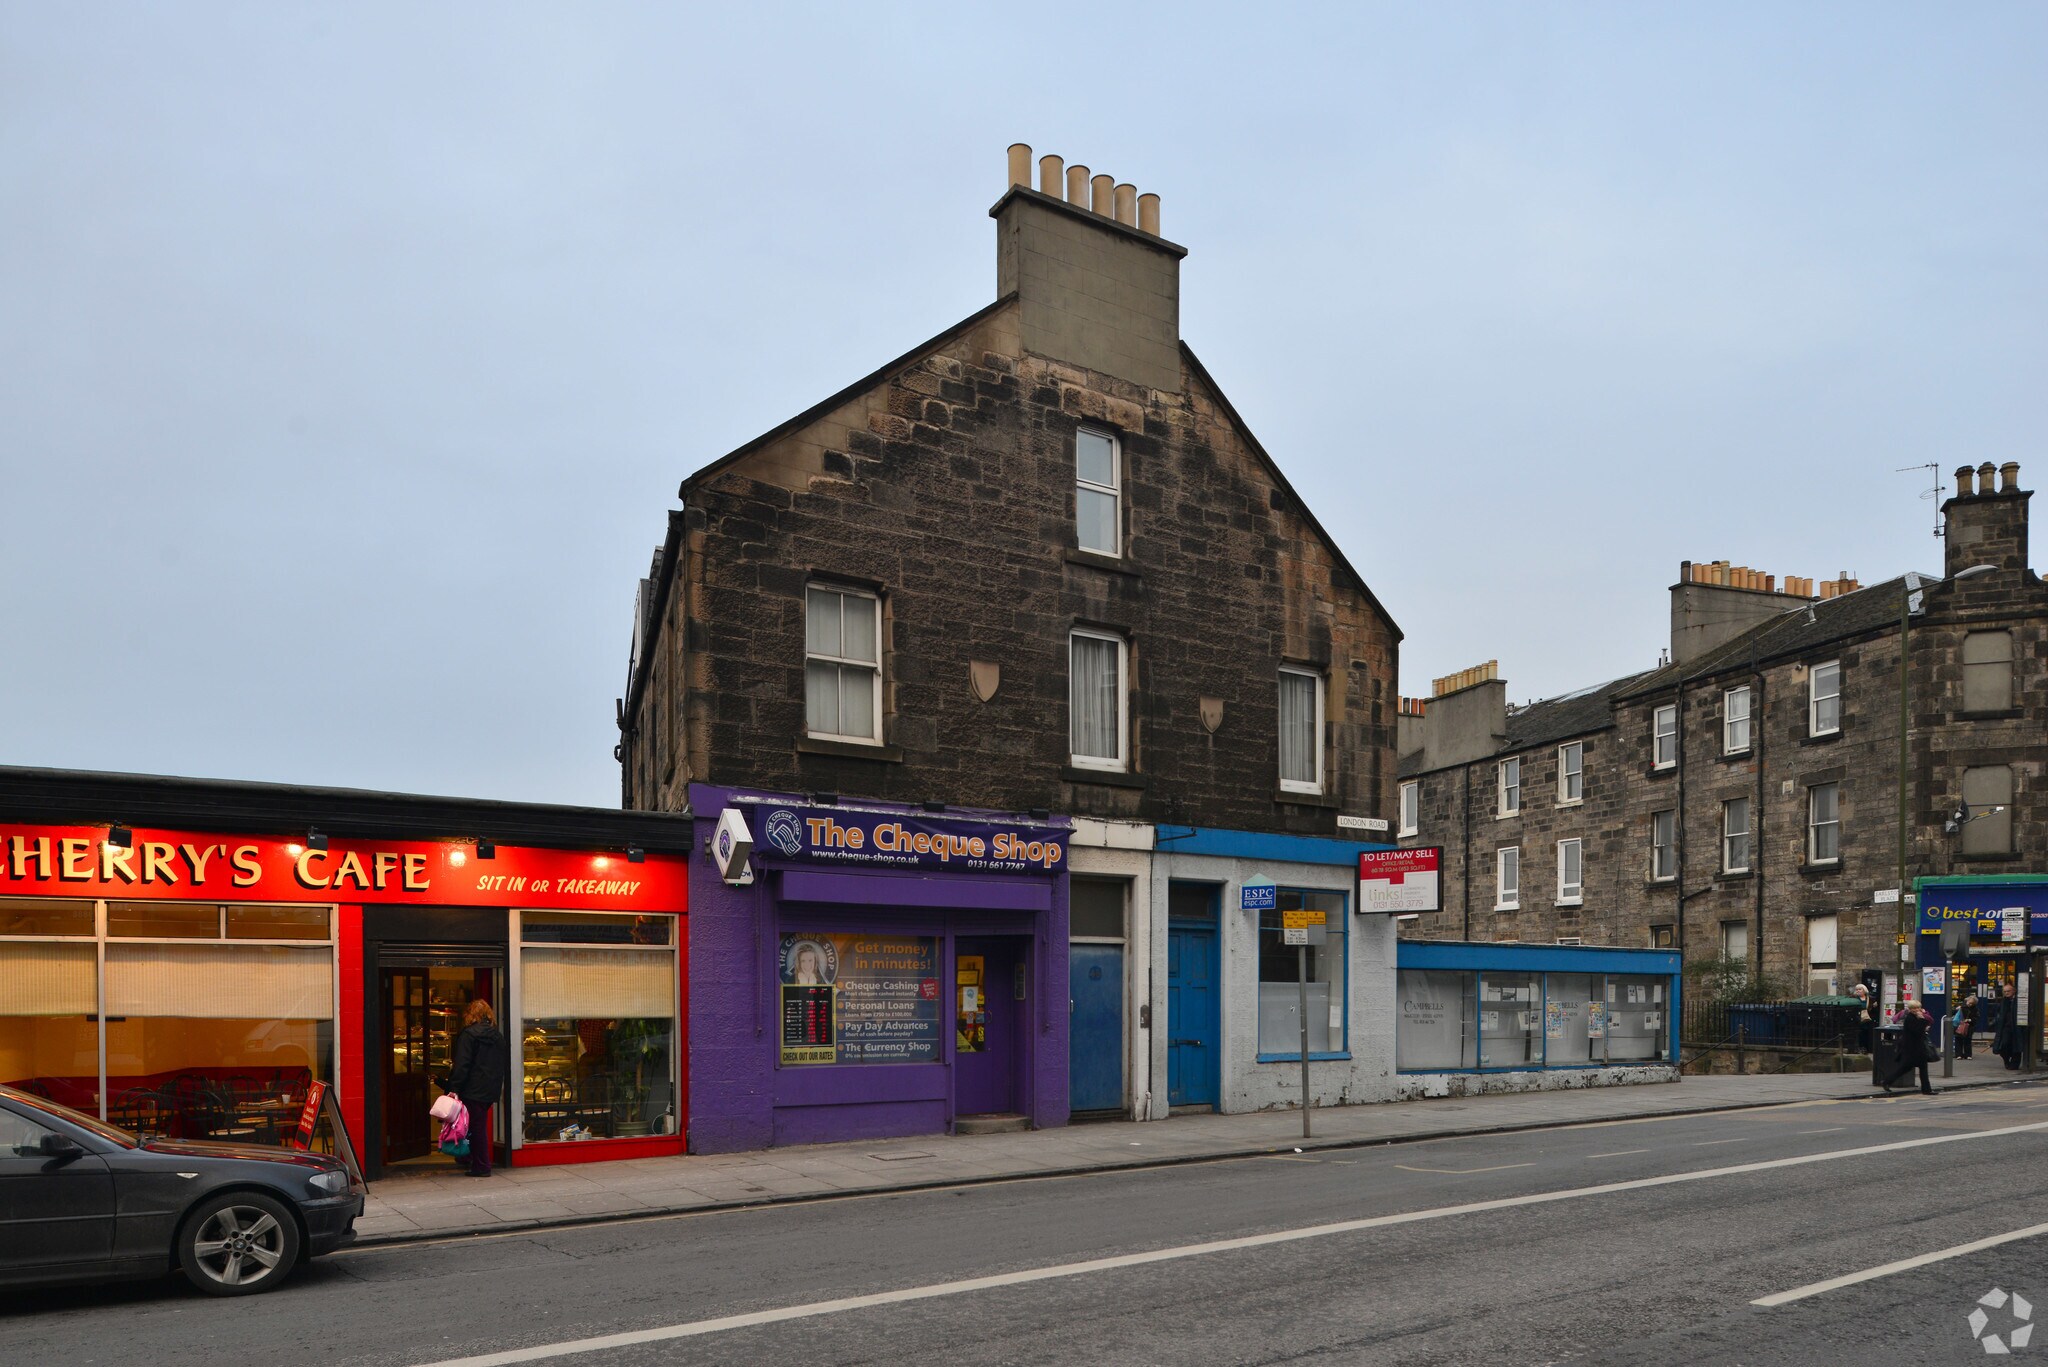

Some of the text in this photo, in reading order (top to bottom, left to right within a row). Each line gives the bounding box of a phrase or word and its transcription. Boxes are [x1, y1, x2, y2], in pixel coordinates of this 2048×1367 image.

[1340, 817, 1386, 829] LONDON ROAD
[806, 817, 1062, 869] The Cheque Shop
[811, 850, 920, 866] www.cheque-shop.co.uk
[1363, 849, 1434, 861] TO LET/MAY SELL
[297, 849, 431, 890] CAFE
[967, 860, 1026, 871] 0131 661 7747
[476, 875, 641, 896] SIT IN OR TAKEAWAY
[1244, 888, 1273, 898] ESPC
[1243, 899, 1273, 907] espc.com
[1373, 899, 1424, 909] 0131 550 3779
[854, 942, 929, 957] Get money
[779, 949, 788, 969] THE
[823, 943, 835, 970] SHOP
[855, 957, 931, 970] in minutes!
[845, 981, 919, 992] Cheque Cashing
[845, 1001, 915, 1010] Personal Loans
[1404, 1000, 1445, 1013] CAMPBELLS
[845, 1022, 929, 1032] Pay Day Advances
[845, 1043, 861, 1052] The
[908, 1042, 931, 1052] Shop
[783, 1051, 834, 1062] CHECK OUT OUR RATES
